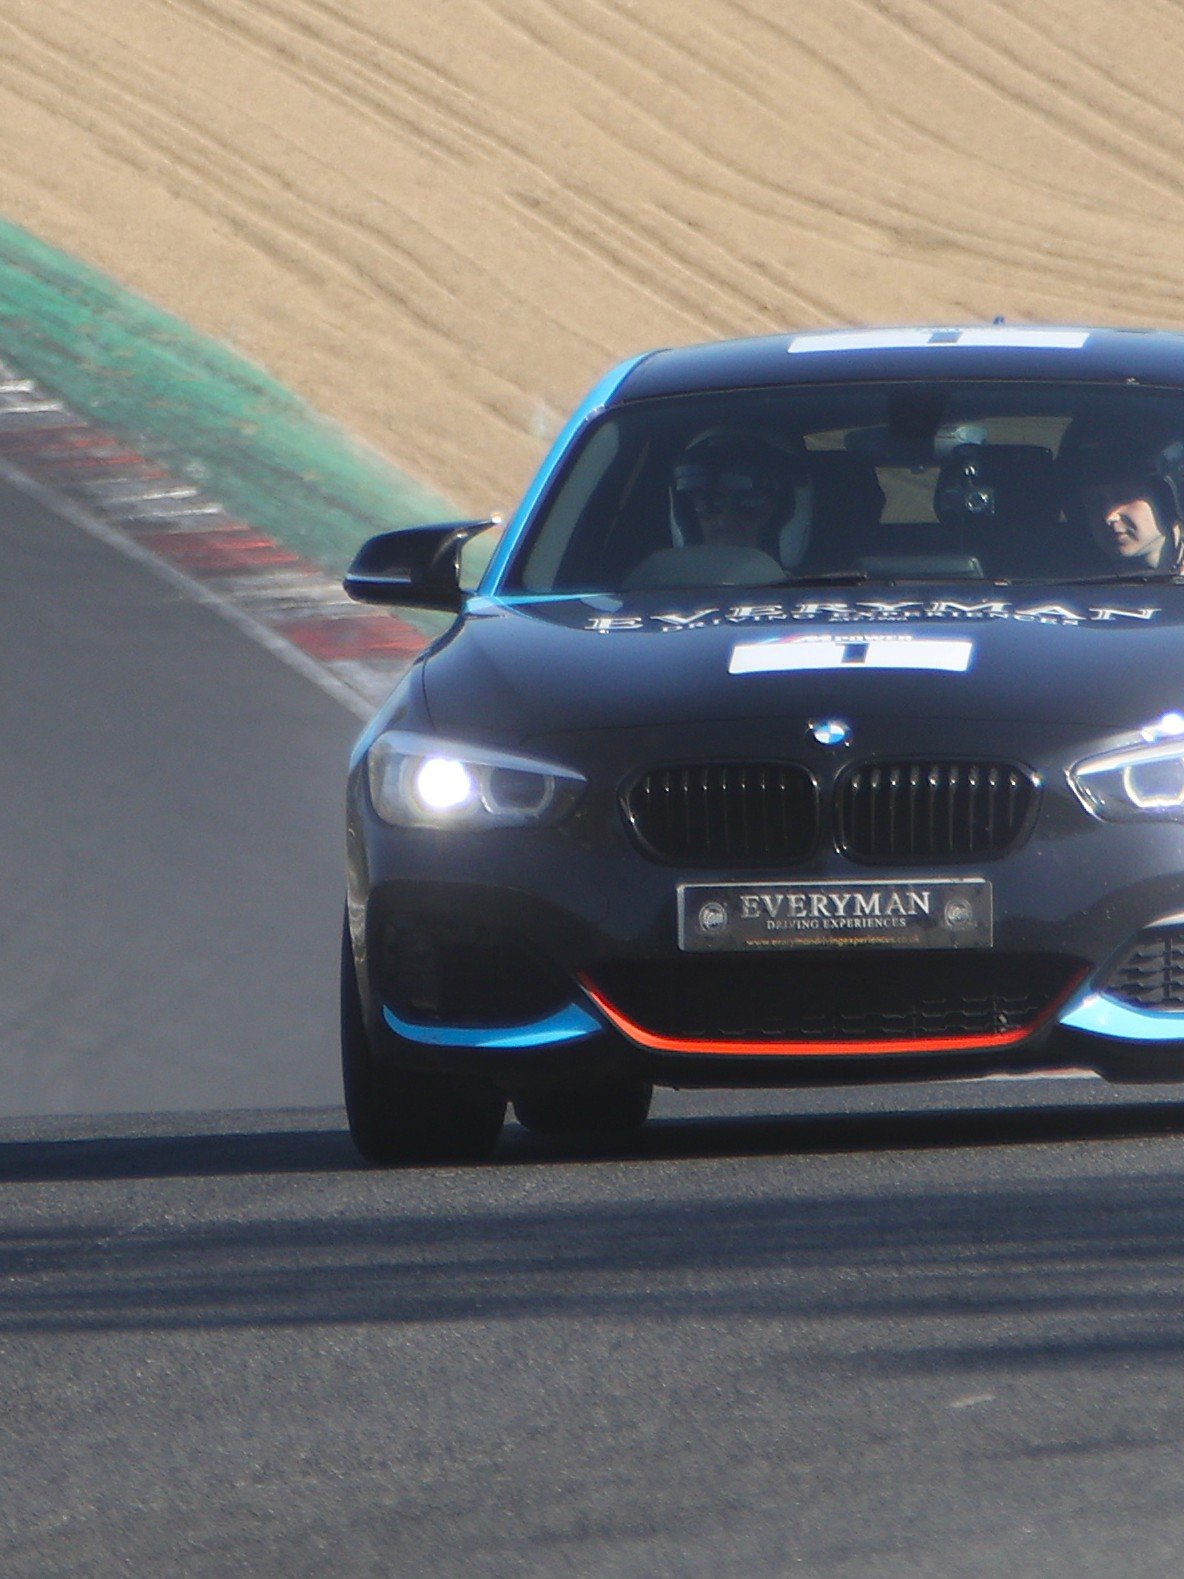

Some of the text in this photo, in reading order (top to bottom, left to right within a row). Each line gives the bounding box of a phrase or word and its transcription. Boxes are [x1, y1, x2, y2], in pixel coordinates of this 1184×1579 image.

[584, 602, 1161, 630] EVERYMAN
[740, 891, 931, 919] EVERYMAN
[767, 917, 907, 930] DRIVING EXPERIENCES
